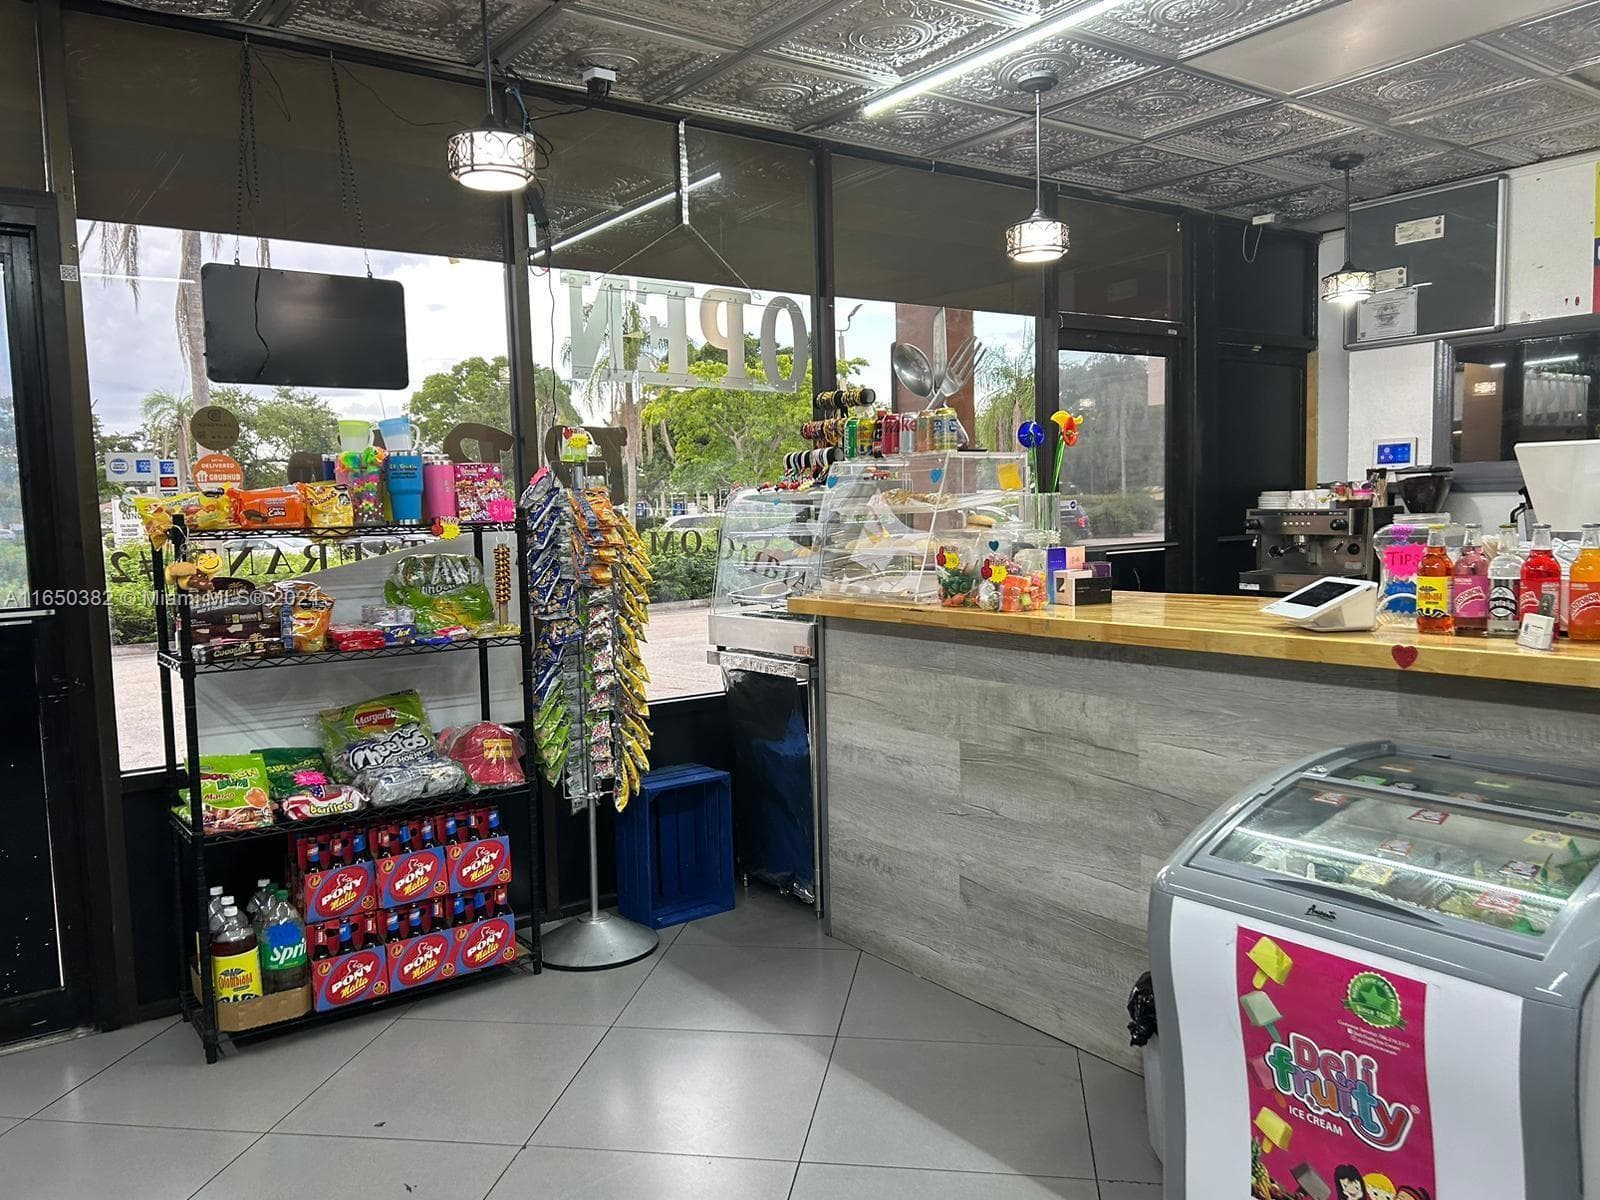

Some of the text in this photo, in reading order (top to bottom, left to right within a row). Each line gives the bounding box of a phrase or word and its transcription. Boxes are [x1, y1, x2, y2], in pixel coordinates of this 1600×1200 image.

[208, 473, 241, 481] GRUBHUB
[309, 801, 354, 815] barrilete
[394, 861, 434, 890] PONY
[462, 849, 500, 876] PONY
[470, 862, 494, 881] Malta
[321, 876, 364, 906] PONY
[403, 876, 429, 895] Malta
[330, 890, 357, 911] Malta
[467, 928, 505, 957] PONY
[475, 943, 499, 962] Malta
[403, 944, 443, 974] PONY
[412, 959, 438, 979] Malta
[331, 961, 375, 993] PONY
[341, 977, 369, 998] Malta
[1290, 1033, 1378, 1096] Deli
[1266, 1043, 1413, 1152] fruity
[1288, 1104, 1344, 1137] ICE CREAM
